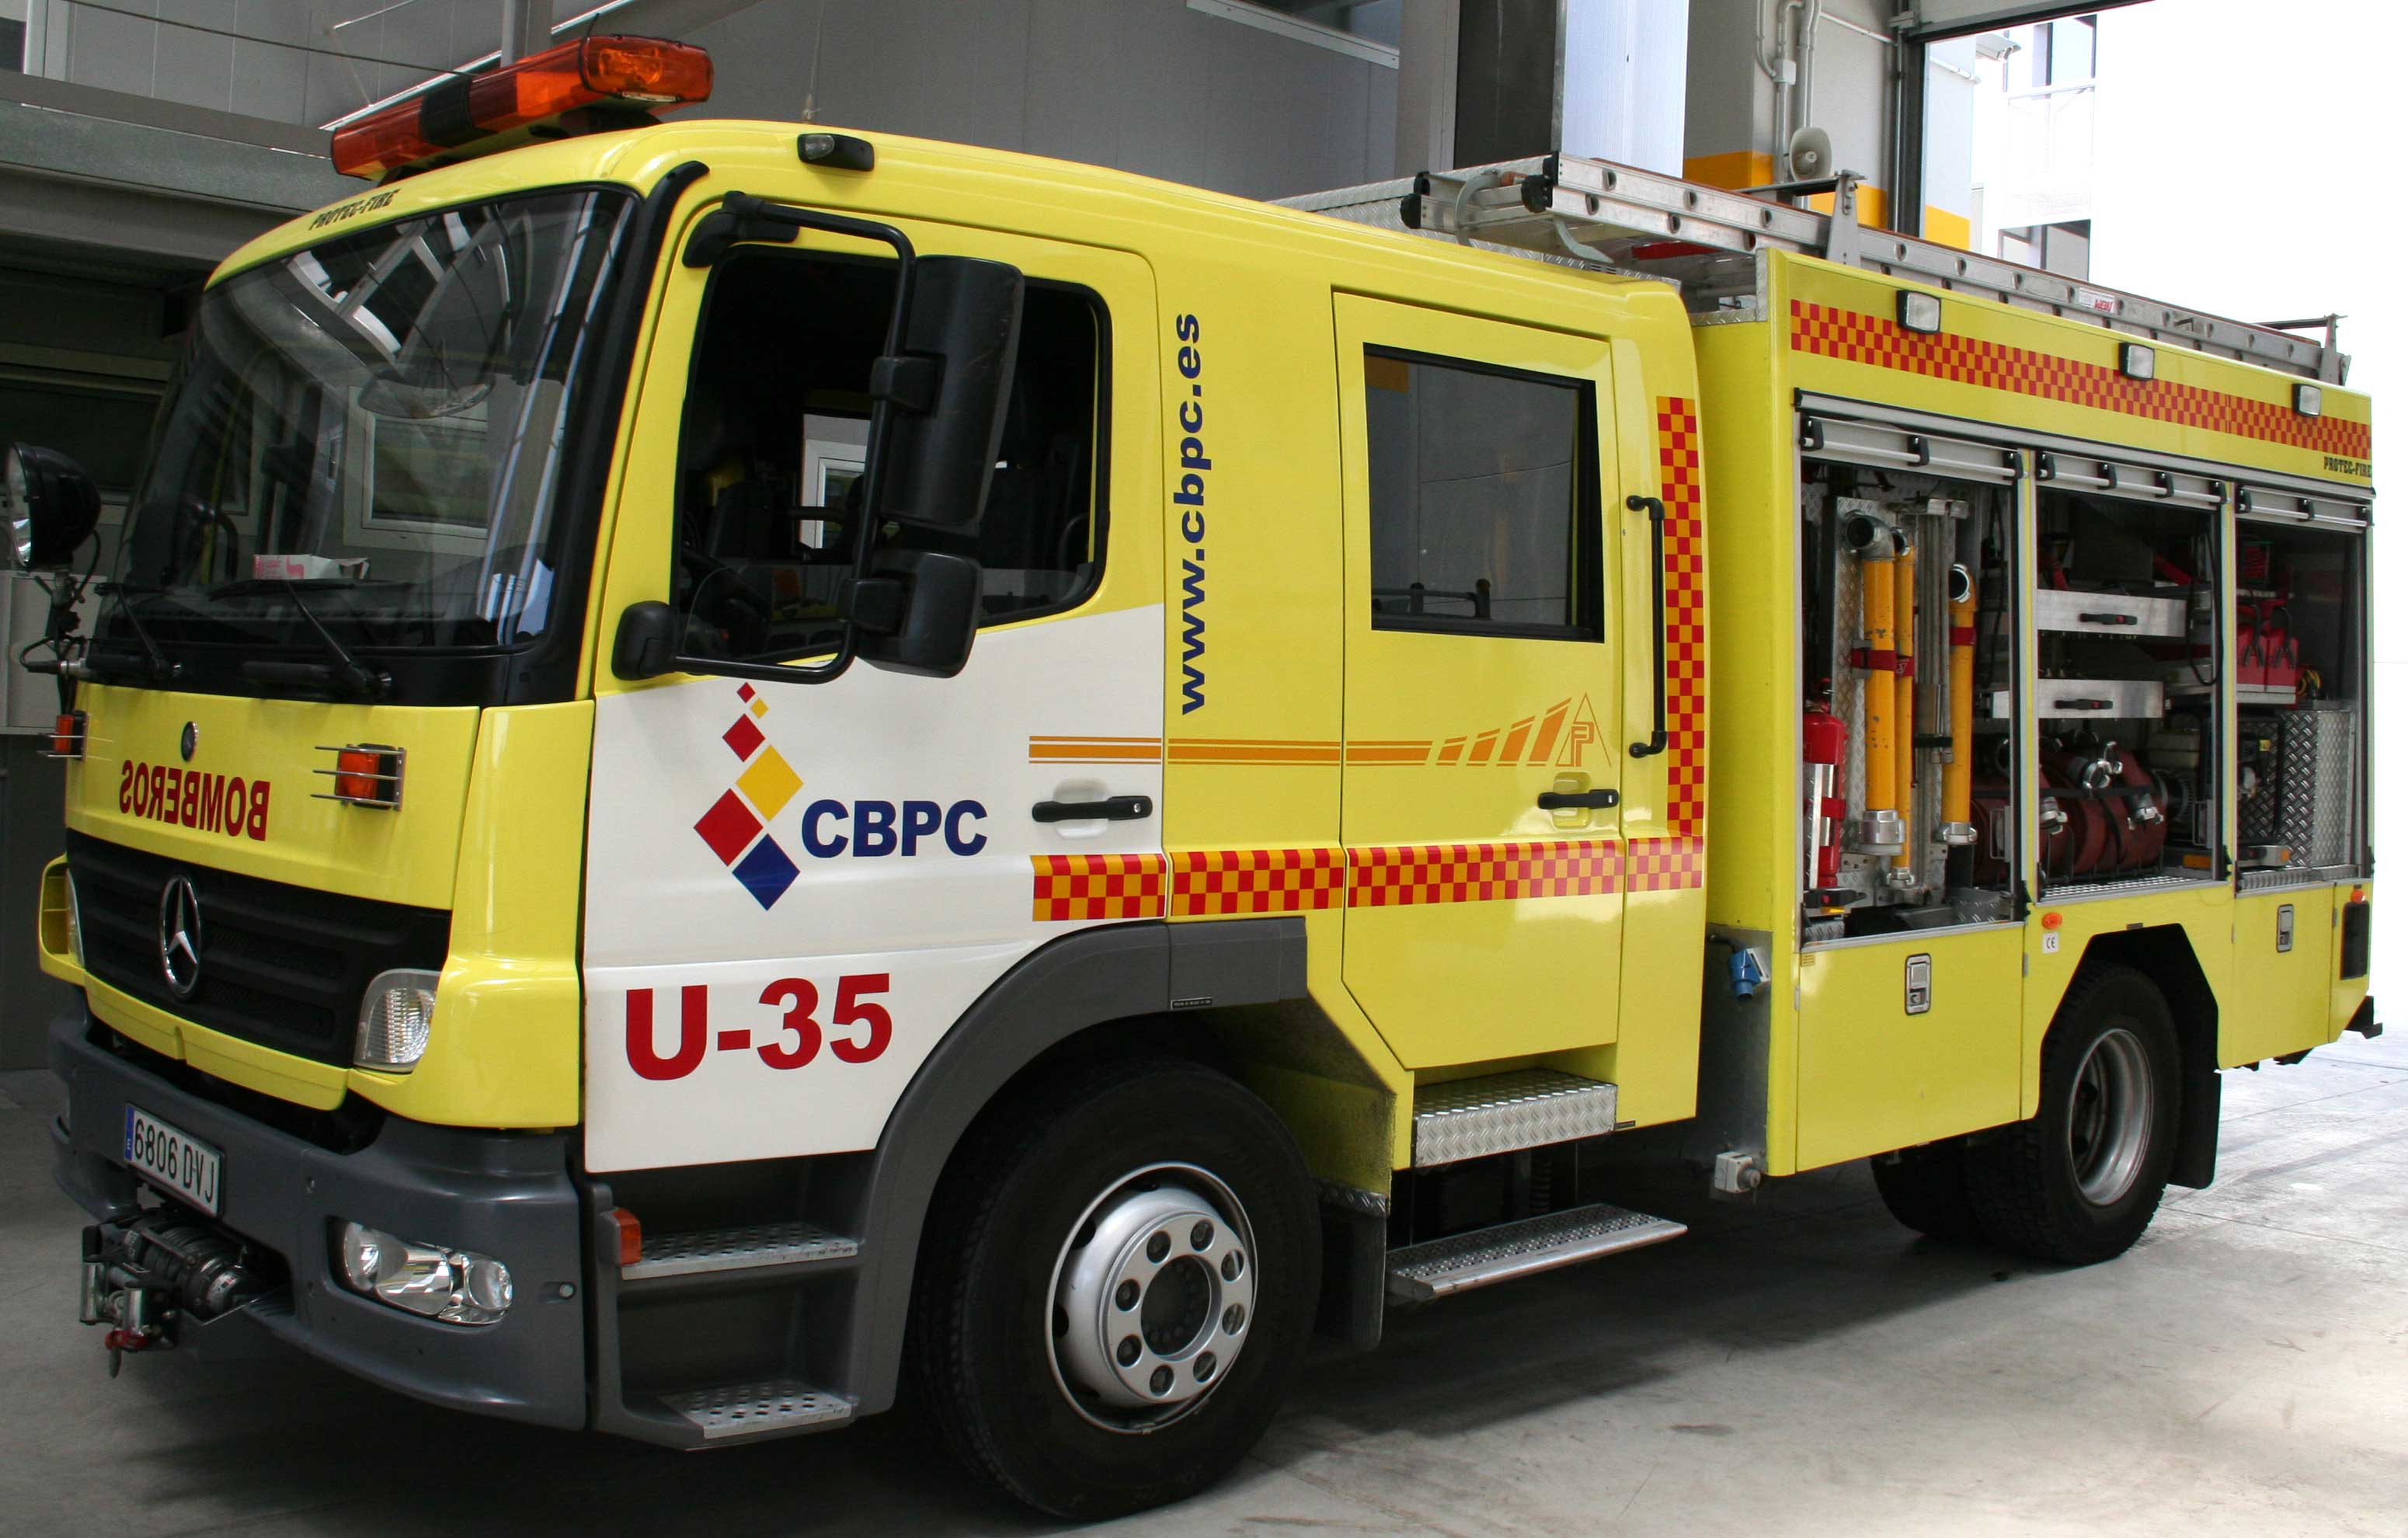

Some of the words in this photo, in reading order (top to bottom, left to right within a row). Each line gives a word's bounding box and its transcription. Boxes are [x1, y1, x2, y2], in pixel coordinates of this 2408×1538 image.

[308, 188, 401, 231] PROTEC-FIRE
[1173, 313, 1212, 715] www.cbpc.es
[801, 799, 988, 858] CBPC
[625, 973, 893, 1081] U-35
[134, 1118, 178, 1179] 6806
[183, 1143, 214, 1203] DVJ
